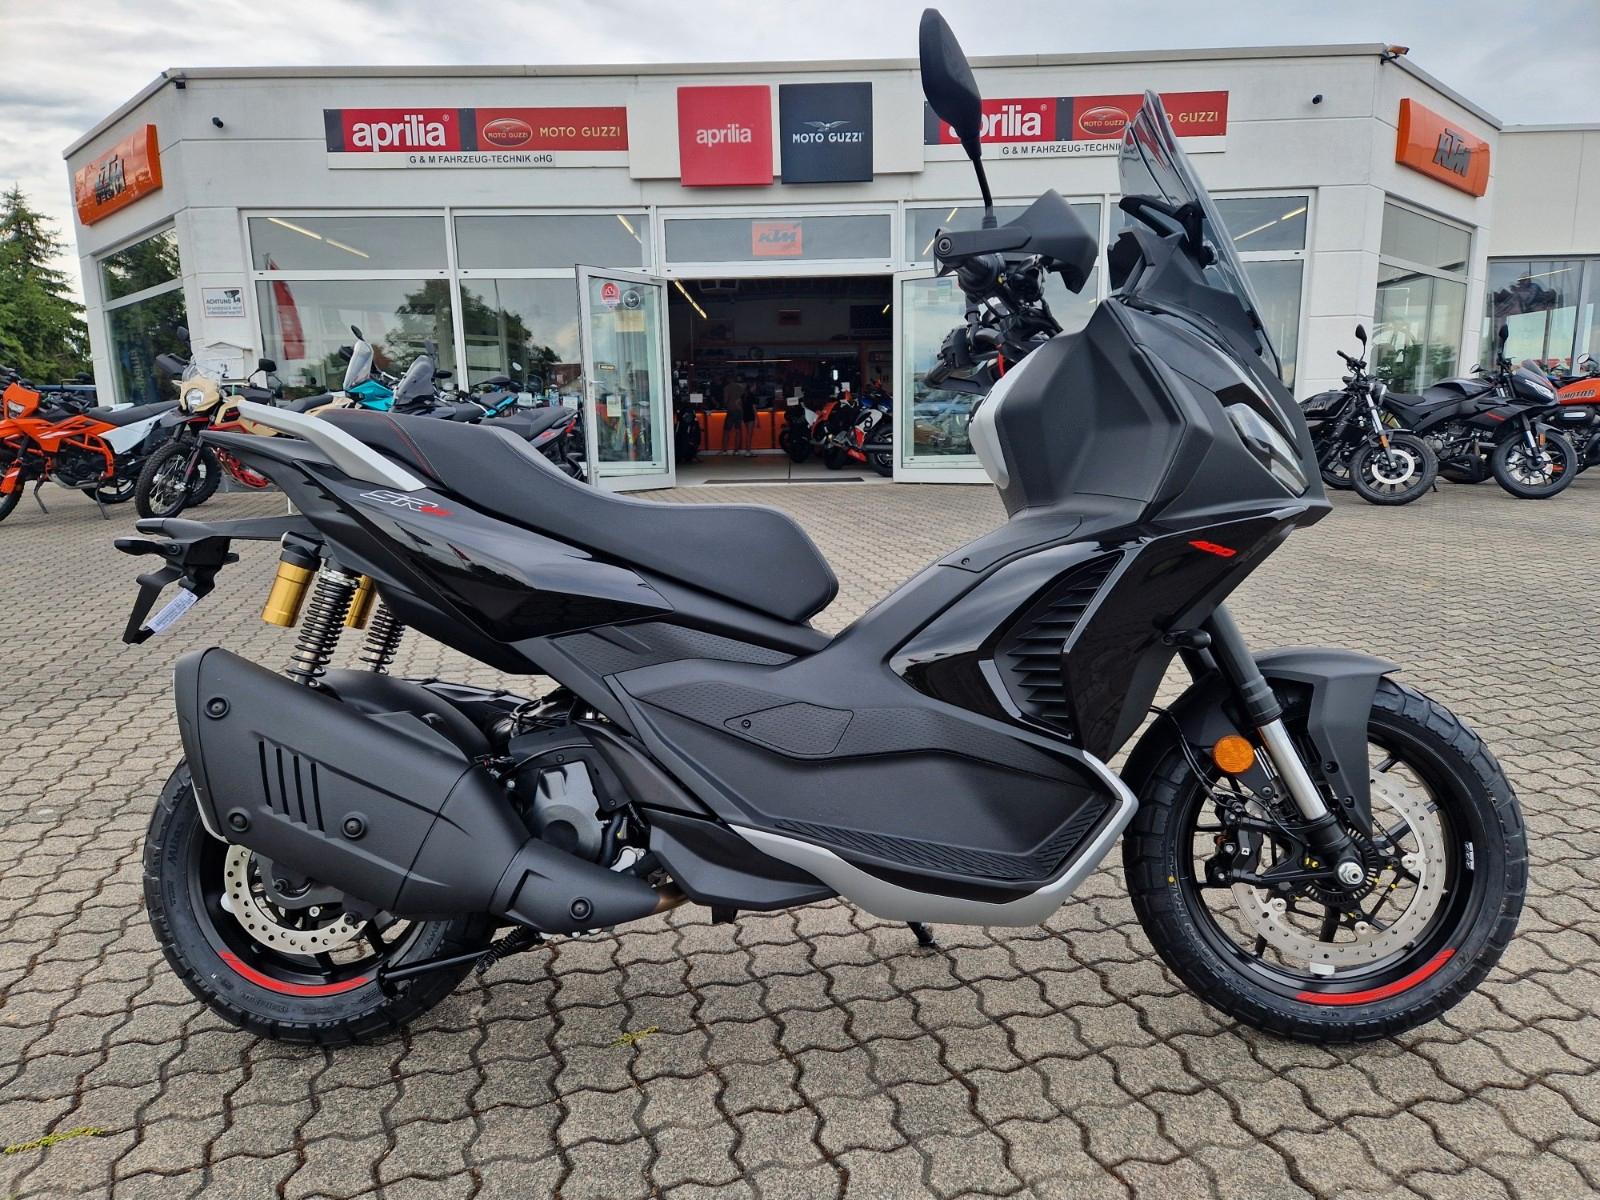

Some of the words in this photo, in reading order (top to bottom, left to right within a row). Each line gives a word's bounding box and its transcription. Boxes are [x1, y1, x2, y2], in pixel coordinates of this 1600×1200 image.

[949, 104, 1042, 139] rilia
[1104, 119, 1125, 127] GUZZI
[1178, 111, 1219, 123] GUZZI
[352, 114, 447, 152] aprilia
[539, 126, 576, 137] MOTO
[582, 126, 621, 137] GUZZI
[696, 124, 752, 147] aprilia
[792, 132, 824, 144] MOTO
[828, 132, 862, 143] GUZZI
[1002, 146, 1009, 155] G
[1012, 146, 1018, 155] &
[1021, 146, 1028, 154] M
[1432, 127, 1472, 178] KTM
[409, 155, 417, 163] G
[420, 155, 426, 163] &
[428, 155, 436, 163] M
[438, 154, 531, 163] FAHRZEUG-TECHNIK
[534, 154, 553, 163] oHG
[758, 229, 799, 244] KTM
